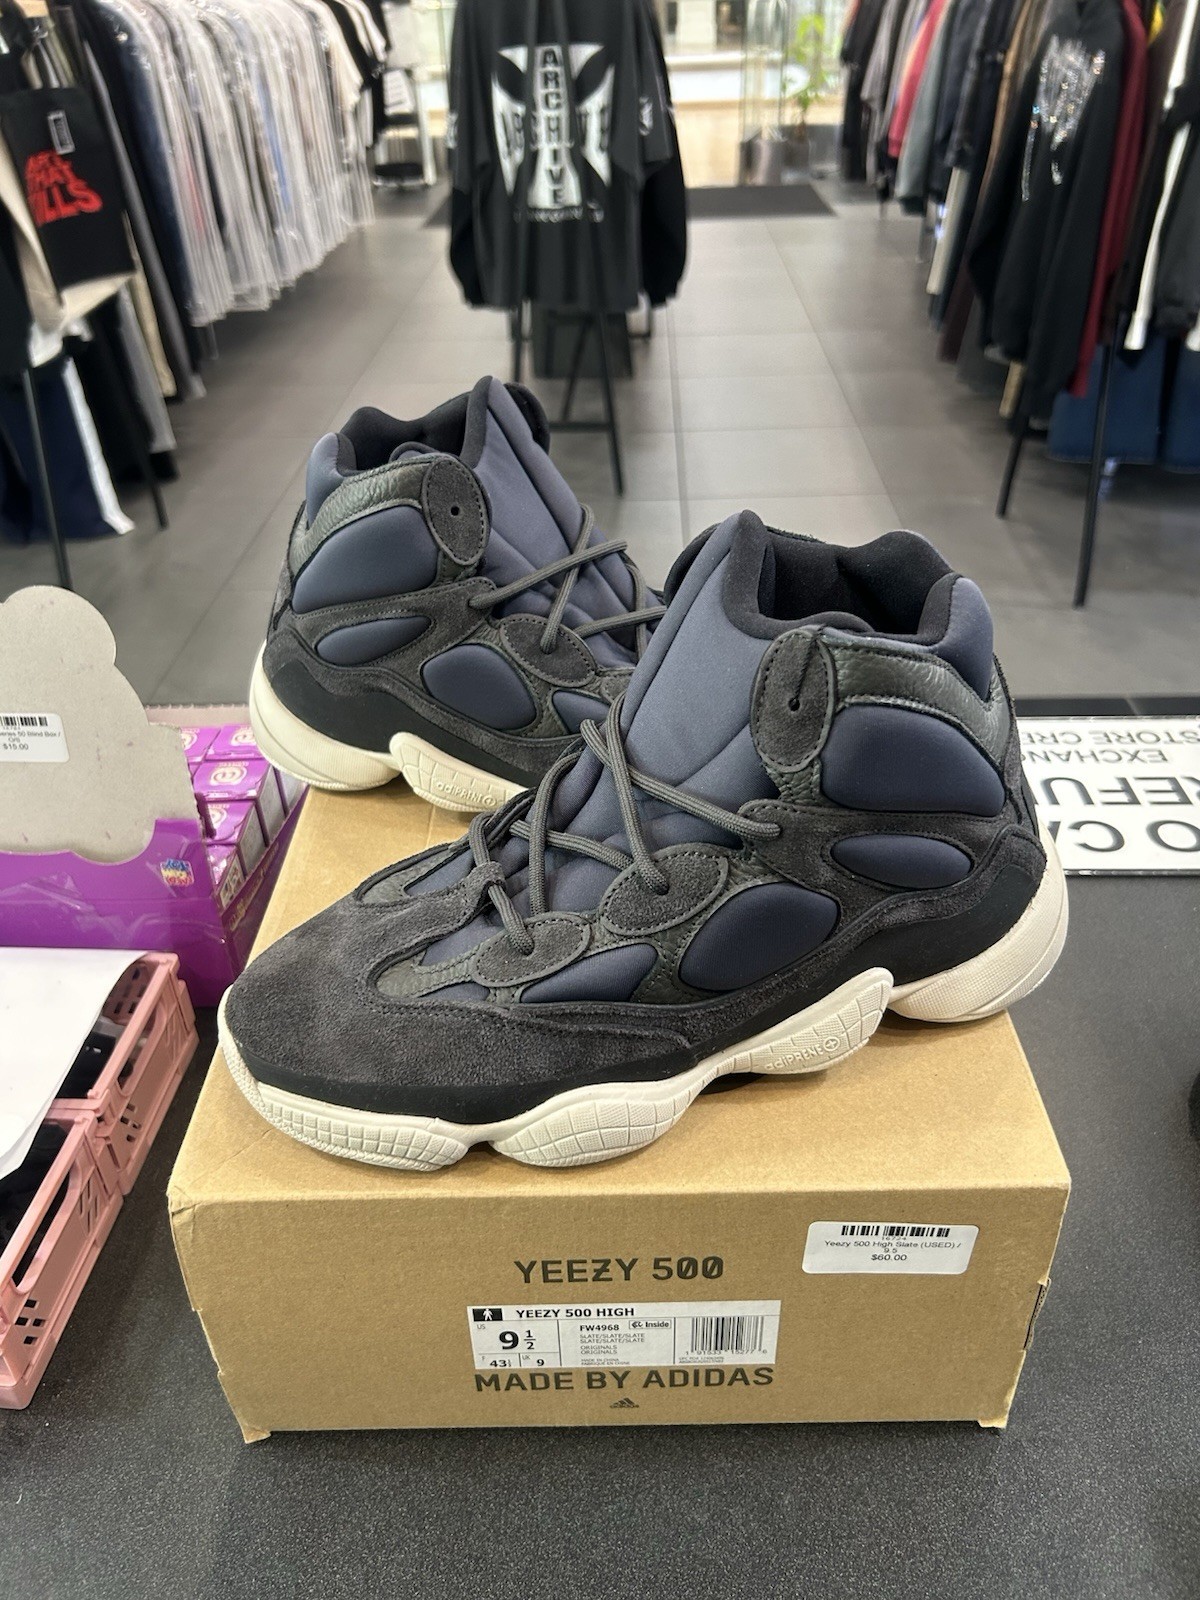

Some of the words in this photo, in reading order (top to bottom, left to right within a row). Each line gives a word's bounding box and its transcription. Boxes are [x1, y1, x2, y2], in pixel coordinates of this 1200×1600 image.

[542, 48, 565, 204] ARCHIVE
[764, 1043, 824, 1071] adiPRENE
[824, 1240, 851, 1248] Yeezy
[920, 1241, 955, 1249] (USED)
[514, 1257, 638, 1284] YEEZY
[652, 1255, 724, 1281] 500
[516, 1309, 561, 1319] YEEZY
[565, 1308, 592, 1318] 500
[596, 1307, 635, 1317] HIGH
[498, 1330, 519, 1350] 9
[536, 1358, 545, 1367] 9
[474, 1371, 574, 1392] MADE
[586, 1369, 631, 1390] BY
[642, 1366, 775, 1389] ADIDAS
